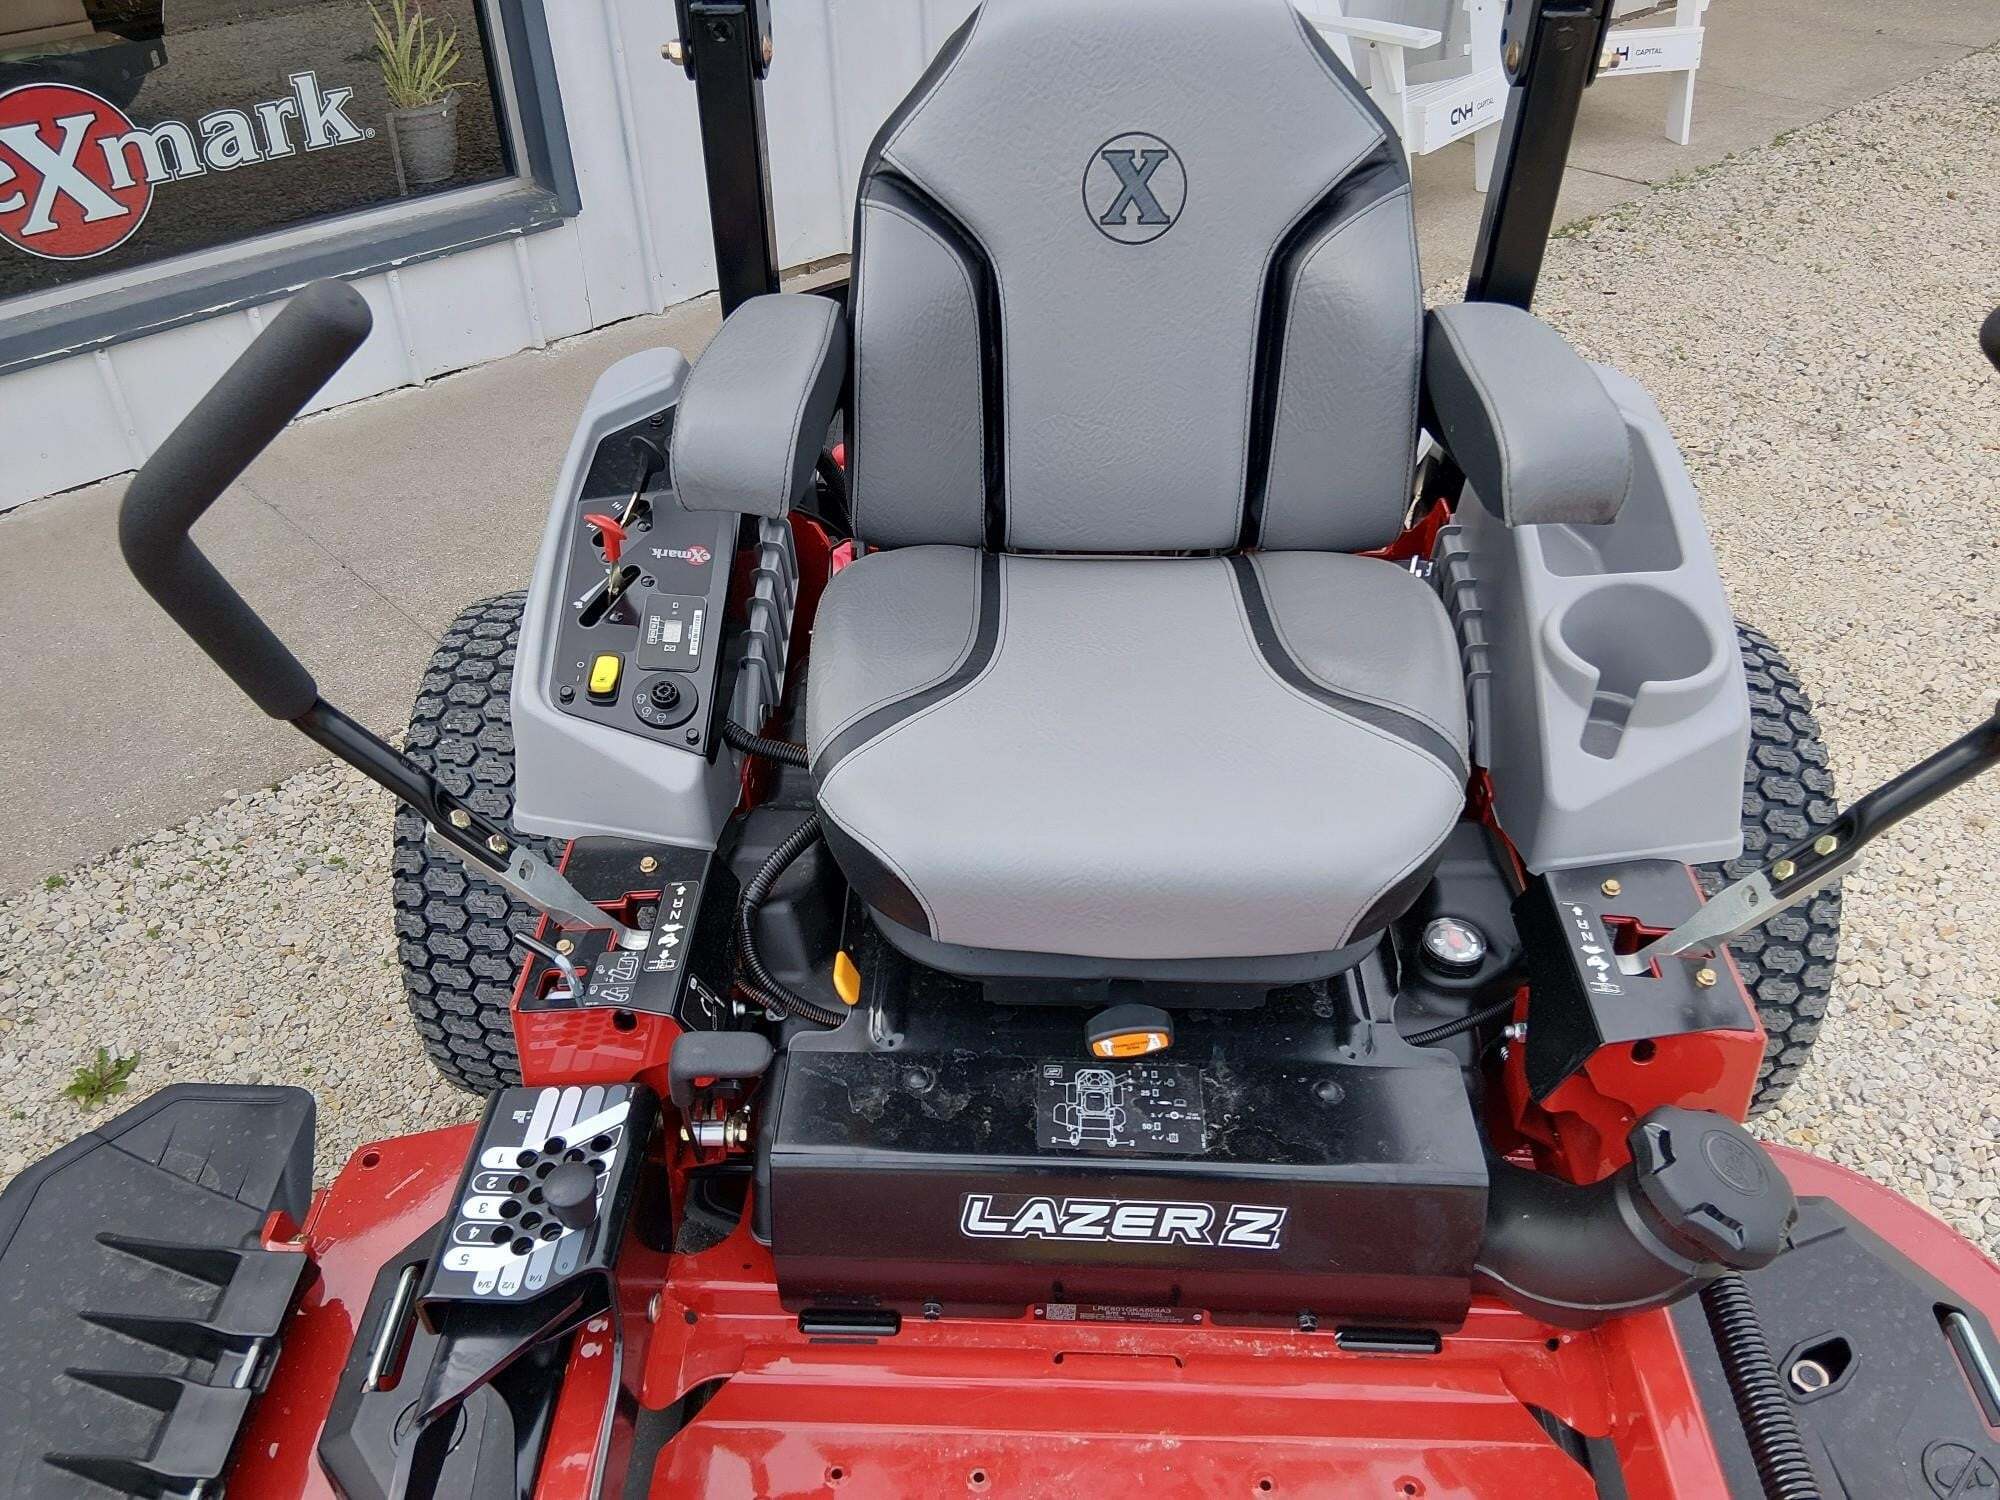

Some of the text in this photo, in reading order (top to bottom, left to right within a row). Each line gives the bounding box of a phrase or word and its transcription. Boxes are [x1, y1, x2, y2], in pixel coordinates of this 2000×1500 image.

[1450, 102, 1473, 125] CNH
[1100, 149, 1170, 225] X
[498, 1153, 503, 1164] 1
[486, 1176, 499, 1189] 2
[478, 1202, 488, 1213] 3
[961, 1195, 1287, 1249] LAZER Z
[469, 1227, 480, 1239] 4
[459, 1253, 470, 1265] 5
[477, 1280, 492, 1289] 3/4
[502, 1281, 515, 1290] 1/2
